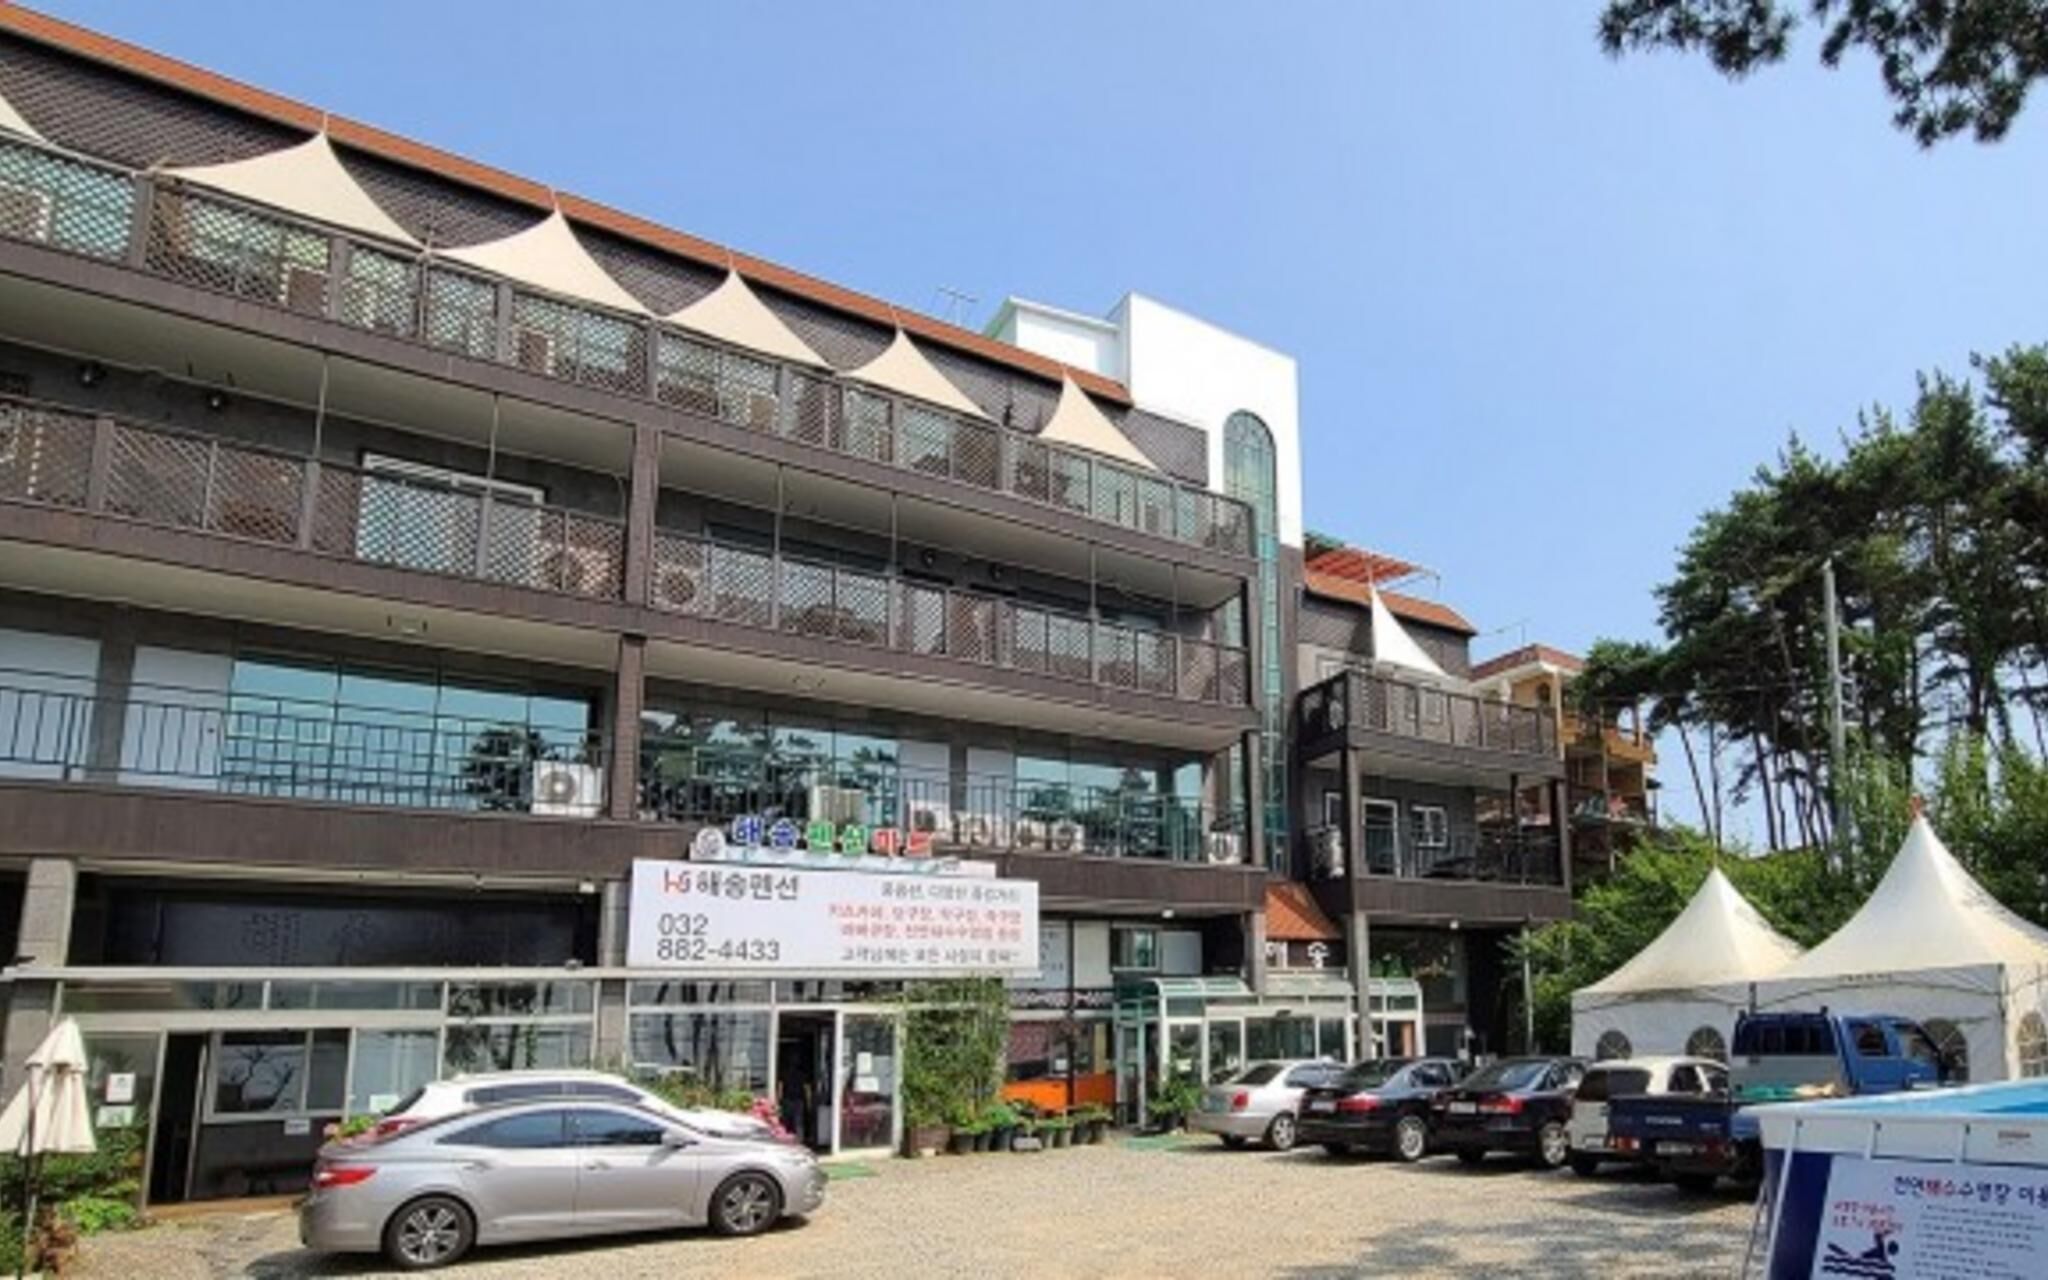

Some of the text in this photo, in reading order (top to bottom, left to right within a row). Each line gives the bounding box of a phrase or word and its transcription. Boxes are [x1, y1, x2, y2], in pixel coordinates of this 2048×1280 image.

[696, 870, 800, 901] 해송펜션
[657, 912, 709, 936] 032
[656, 937, 781, 962] 882-4433
[1893, 1174, 2012, 1206] 천연해수수영장
